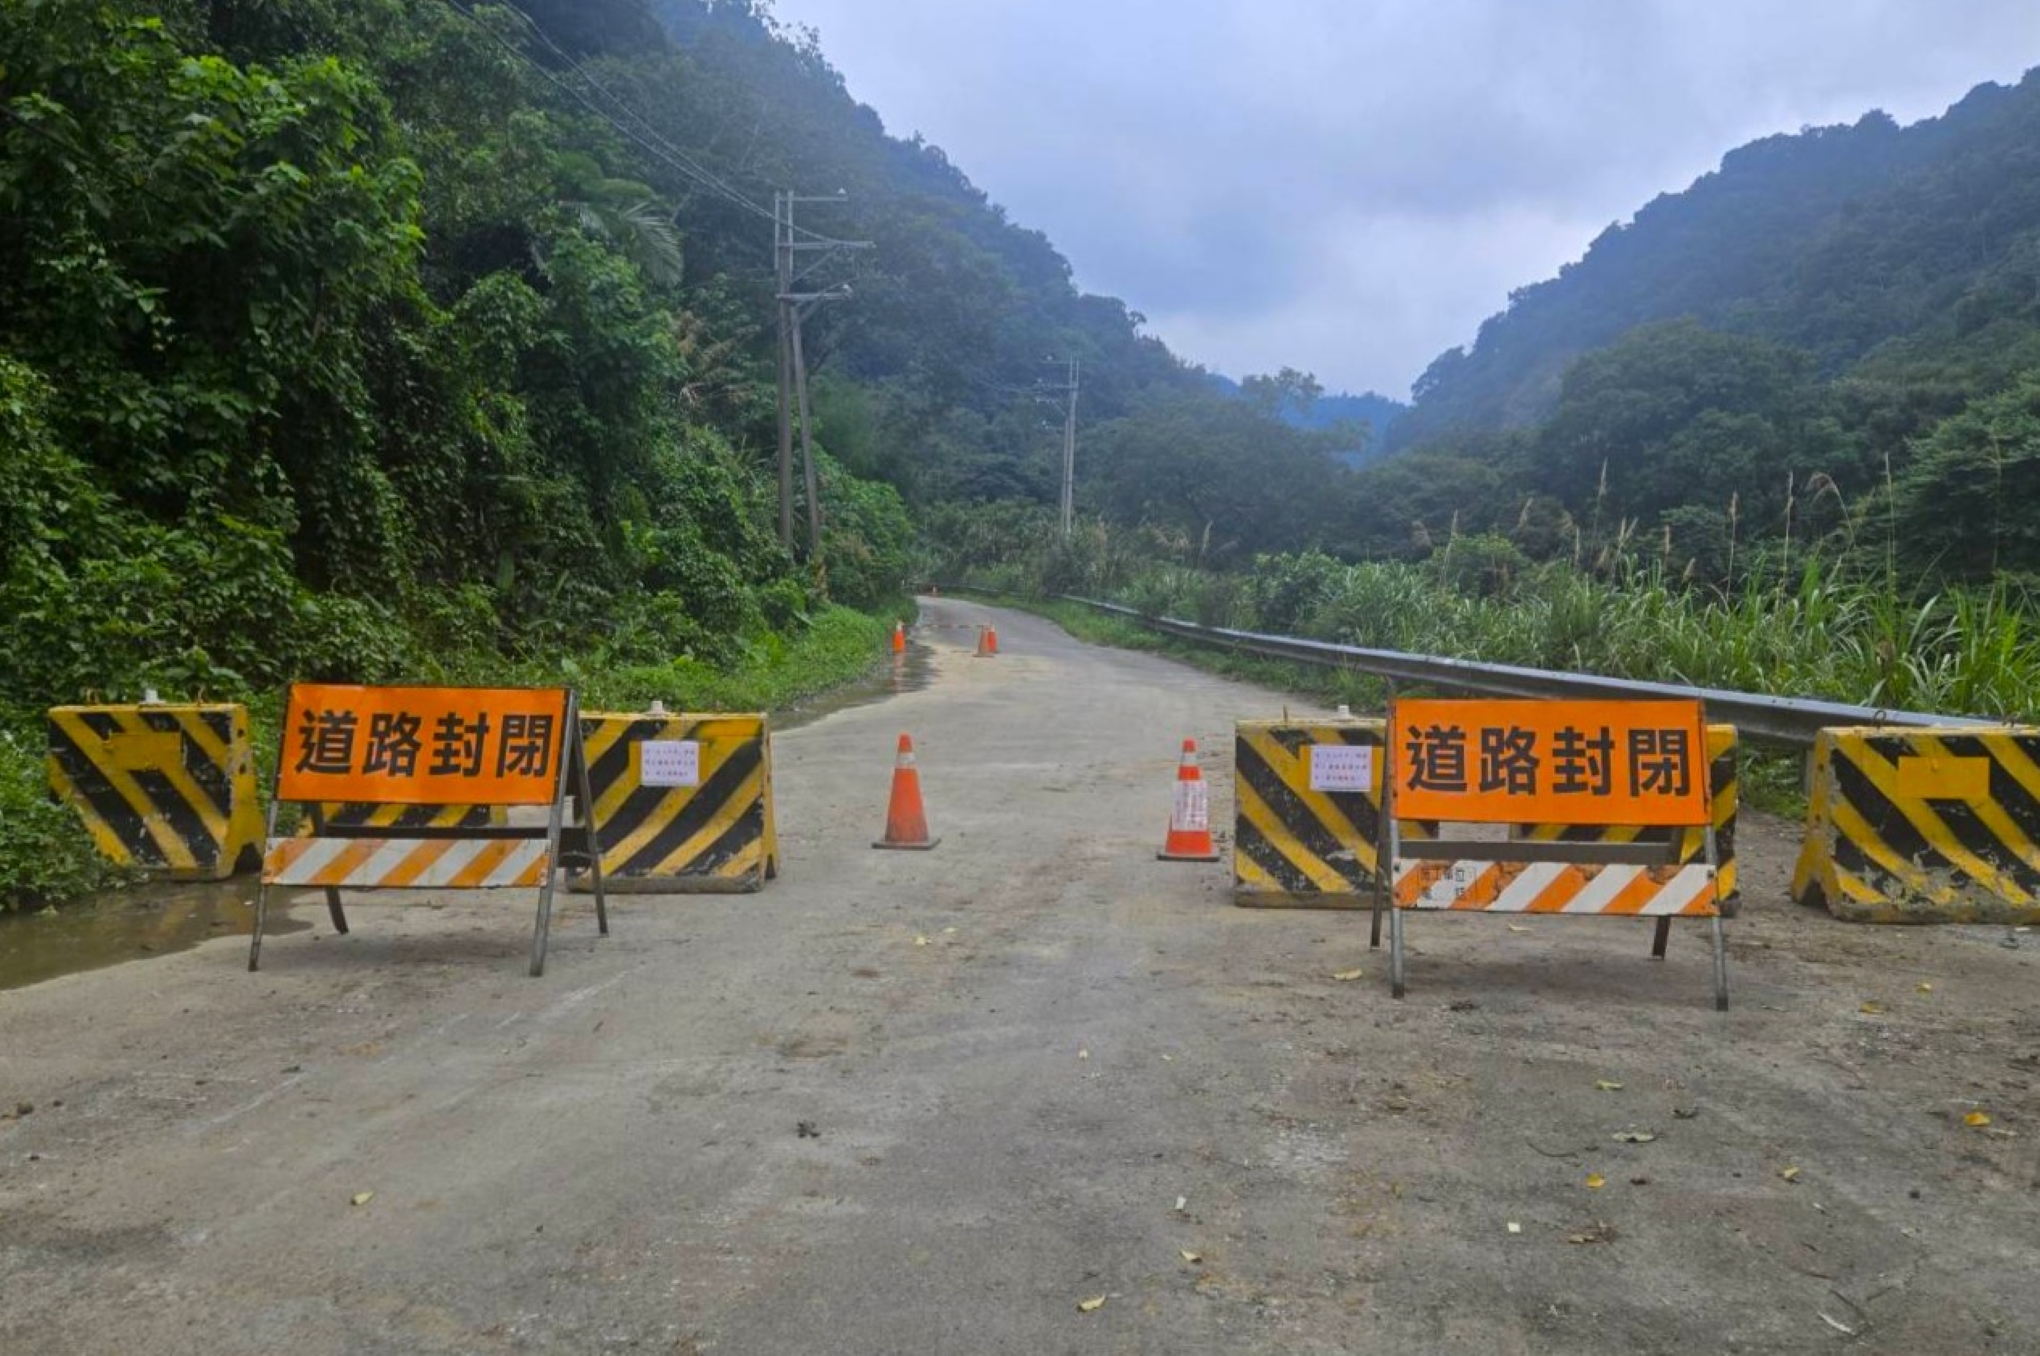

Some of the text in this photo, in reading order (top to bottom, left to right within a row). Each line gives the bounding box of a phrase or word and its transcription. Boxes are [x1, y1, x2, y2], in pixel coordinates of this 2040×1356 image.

[295, 709, 554, 778] 道路封閉
[1406, 725, 1691, 797] 道路封閉
